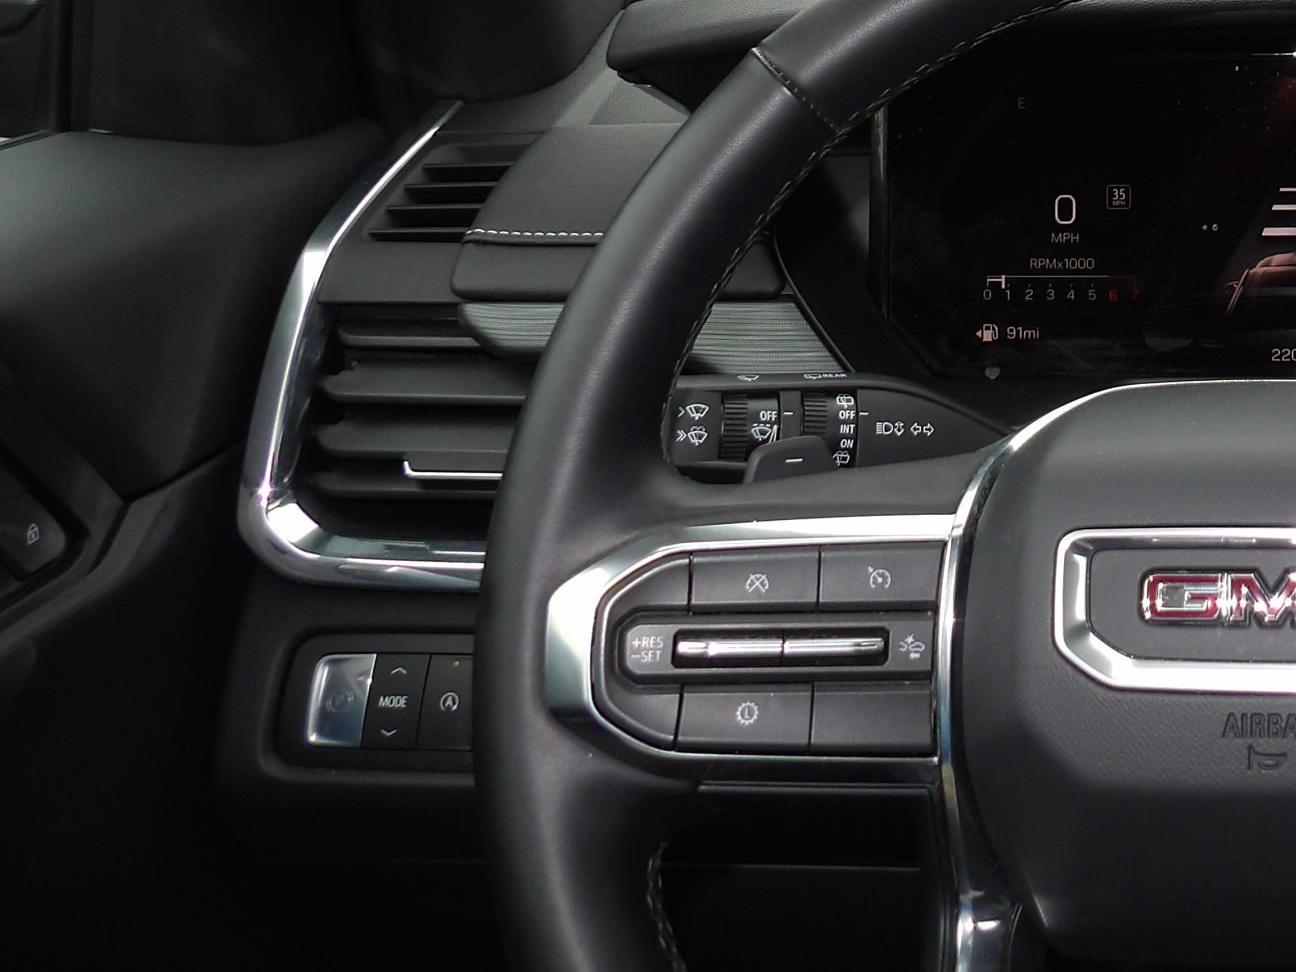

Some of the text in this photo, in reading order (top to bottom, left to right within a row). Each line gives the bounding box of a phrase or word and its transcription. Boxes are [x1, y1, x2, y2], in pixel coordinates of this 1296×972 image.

[1017, 97, 1026, 109] E
[1112, 188, 1126, 200] 35
[1054, 195, 1076, 224] 0
[1051, 233, 1079, 244] MPH
[1029, 258, 1095, 270] RPMx1000
[983, 289, 991, 301] 0
[1005, 289, 1011, 301] 1
[1024, 289, 1034, 301] 2
[1046, 289, 1055, 301] 3
[1066, 289, 1075, 301] 4
[1088, 289, 1097, 301] 5
[1109, 289, 1118, 301] 6
[1006, 327, 1040, 340] 91mi
[760, 410, 777, 422] OFF
[839, 410, 856, 420] OFF
[840, 424, 855, 434] INT
[840, 439, 854, 448] ON
[379, 695, 407, 708] MODE
